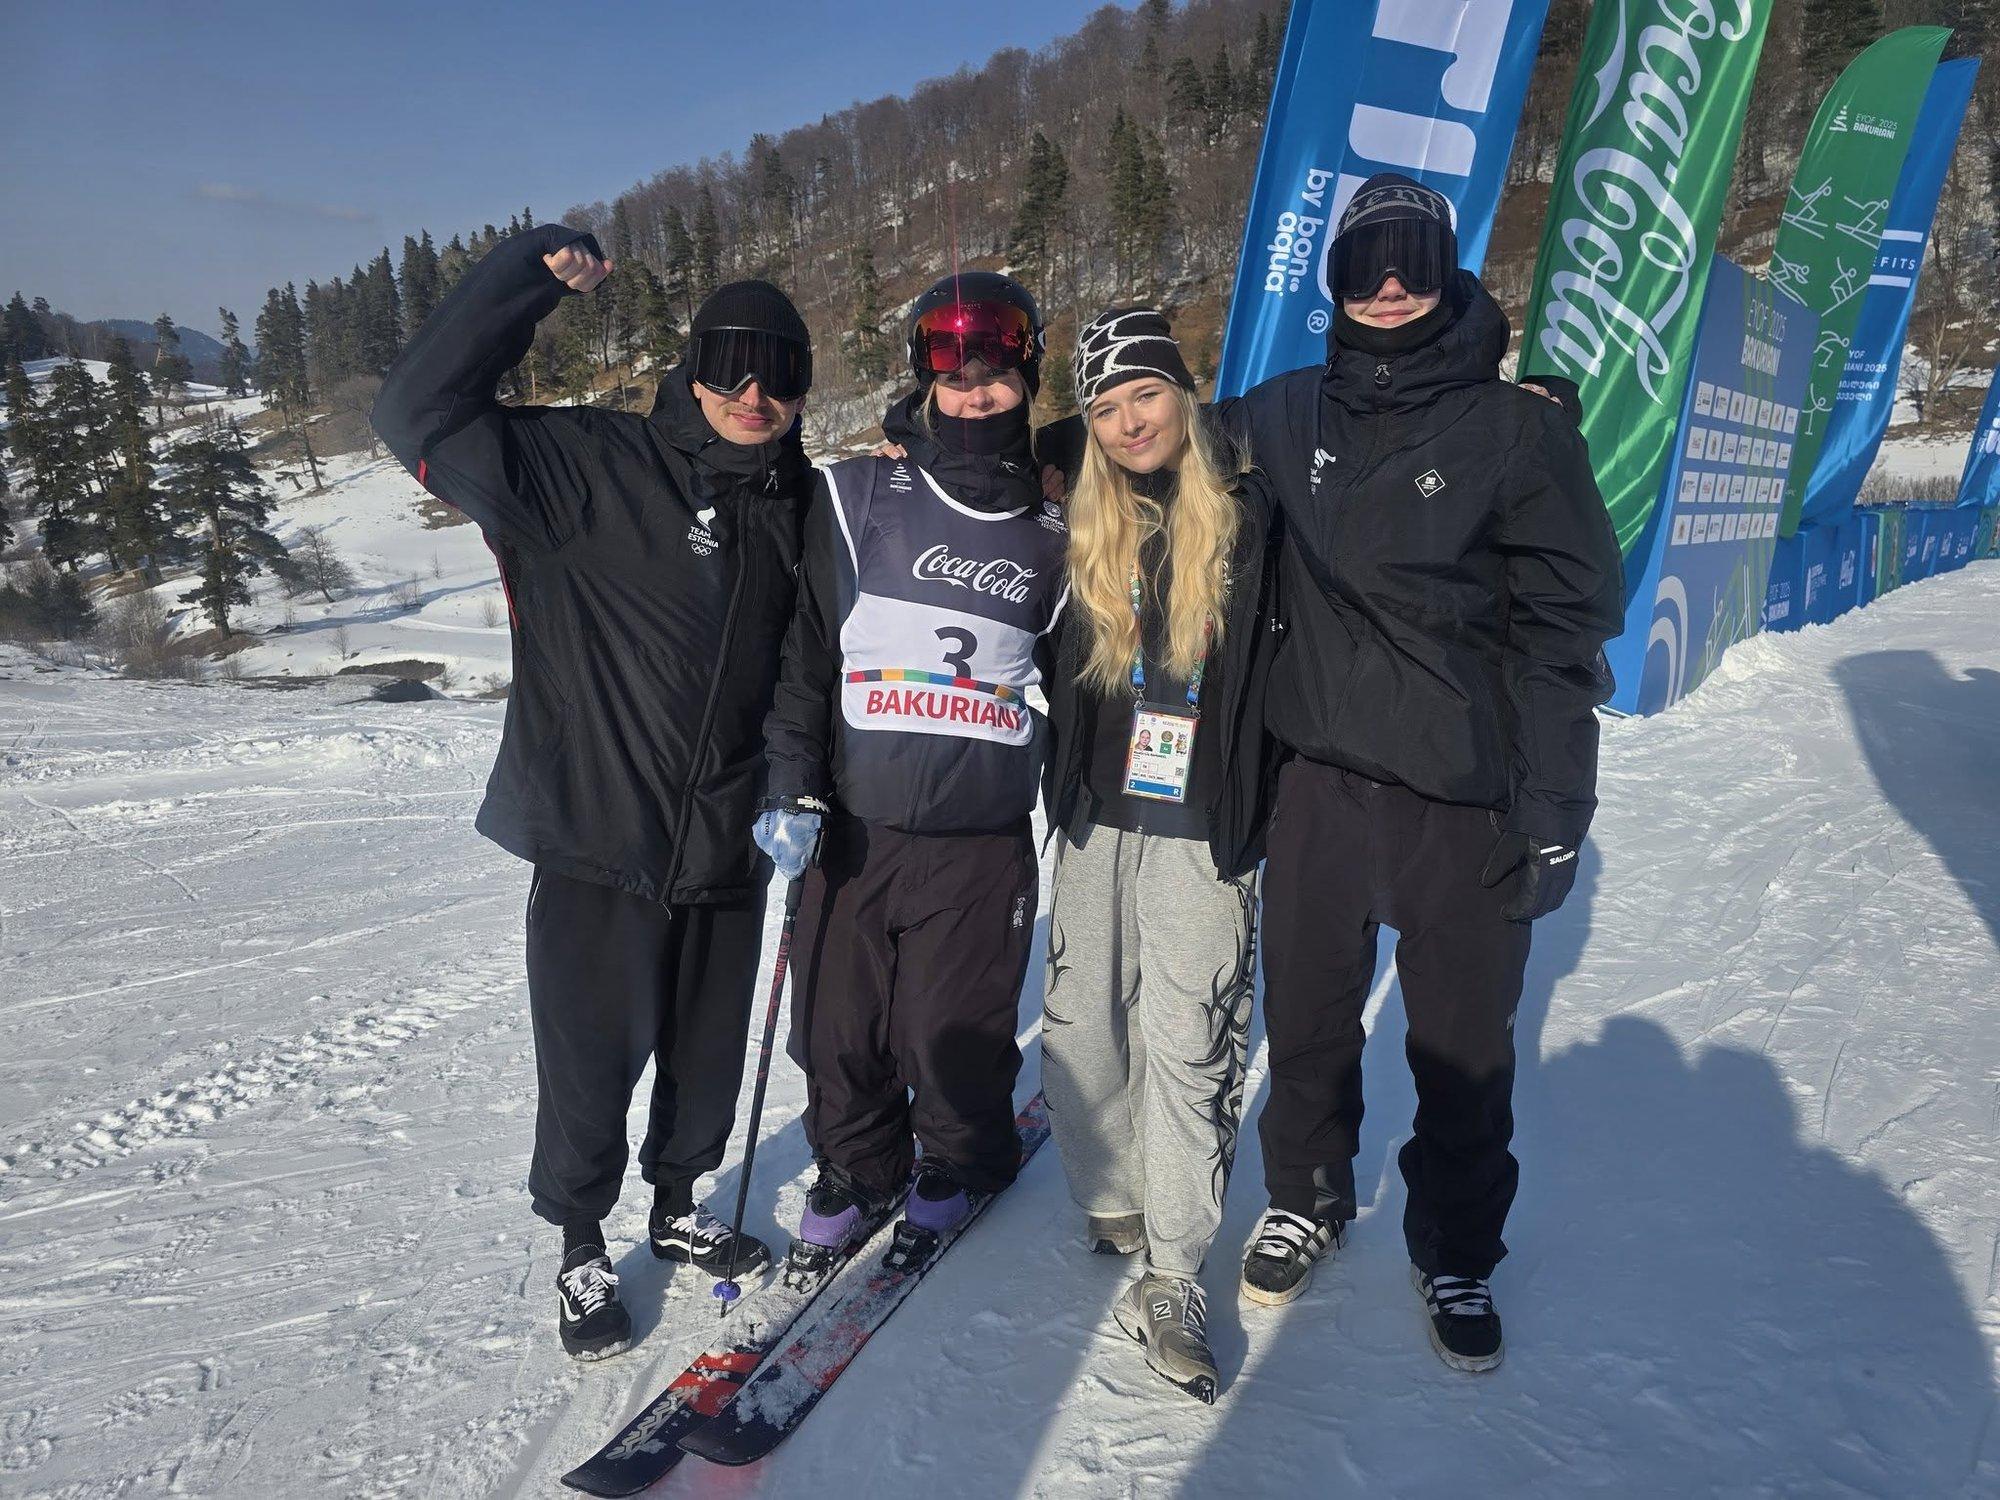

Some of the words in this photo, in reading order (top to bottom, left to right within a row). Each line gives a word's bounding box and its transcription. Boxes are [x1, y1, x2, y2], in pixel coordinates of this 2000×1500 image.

[1853, 122, 1896, 140] BAKURIANI
[1879, 118, 1898, 130] 2025
[1302, 168, 1334, 208] by
[1264, 211, 1298, 292] aqua
[1873, 256, 1916, 270] FITS
[1849, 349, 1866, 359] YOF
[690, 526, 711, 538] TEAM
[687, 533, 719, 548] ESTONIA
[934, 626, 978, 679] 3
[866, 689, 1022, 731] BAKURIANI
[1173, 787, 1179, 795] R
